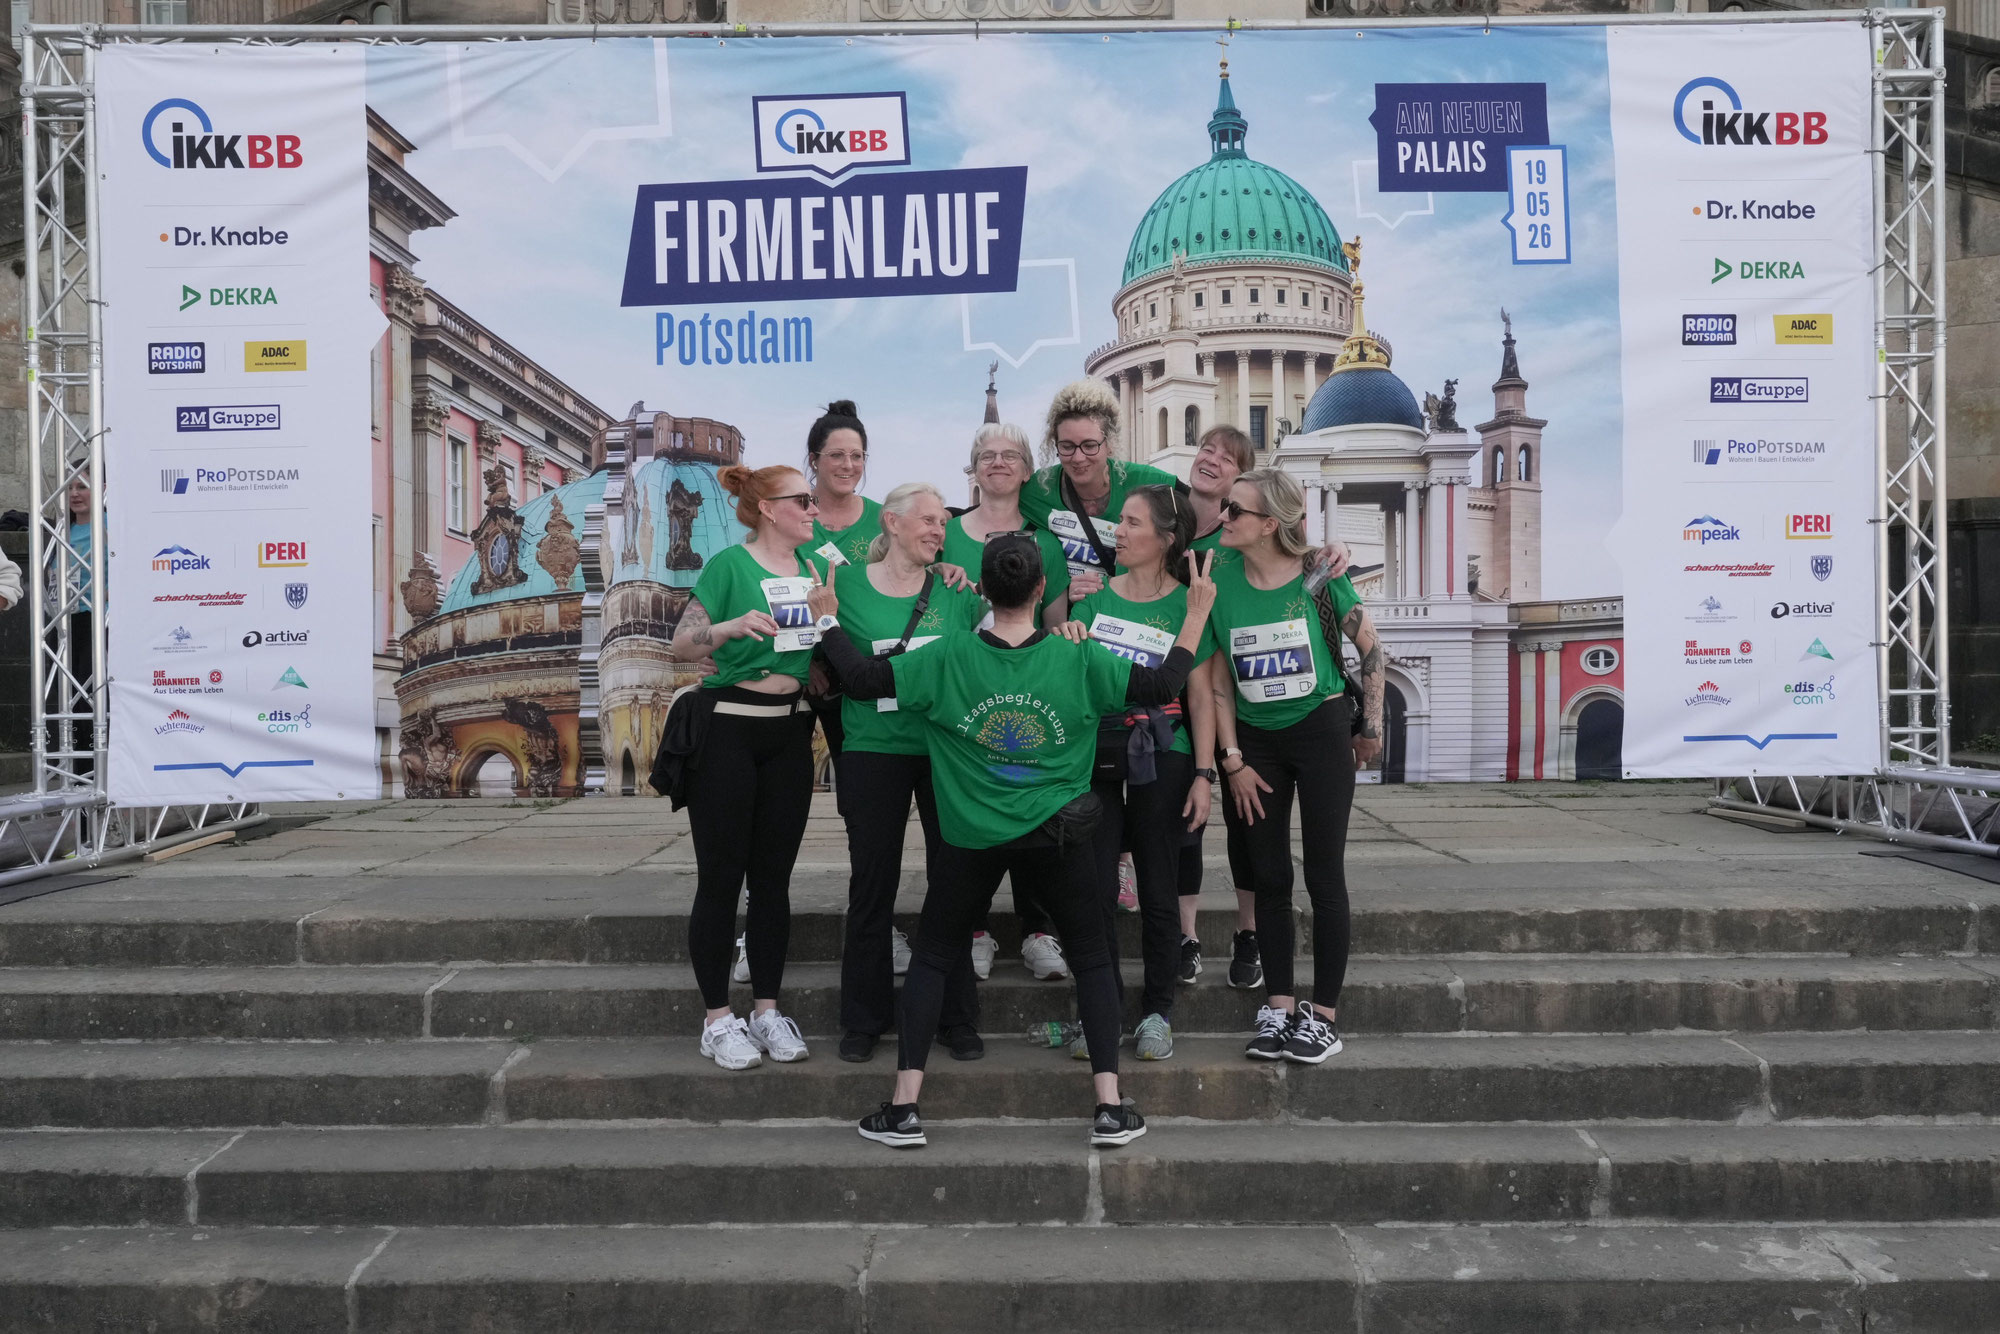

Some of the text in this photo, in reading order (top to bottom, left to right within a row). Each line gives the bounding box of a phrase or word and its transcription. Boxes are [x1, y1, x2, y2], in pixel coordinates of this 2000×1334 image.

[1396, 102, 1524, 134] AM NEUEN
[1398, 140, 1486, 173] PALAIS
[1525, 160, 1546, 184] 19
[1526, 192, 1550, 216] 05
[1707, 200, 1816, 220] Dr. Knabe
[174, 226, 289, 246] Dr. Knabe
[654, 191, 1000, 284] FIRMENLAUF
[1528, 224, 1552, 248] 26
[1740, 261, 1805, 280] DEKRA
[210, 287, 278, 306] DEKRA
[1685, 317, 1733, 332] RADIO
[1791, 320, 1817, 330] ADAC
[656, 310, 813, 366] Potsdam
[151, 346, 202, 360] RADIO
[262, 346, 290, 358] ADAC
[1714, 382, 1804, 399] 2M Gruppe
[180, 411, 276, 427] 2M Gruppe
[1793, 514, 1831, 533] PERI
[1683, 525, 1740, 545] impeak
[266, 542, 306, 560] PERI
[152, 554, 210, 575] impeak
[1684, 562, 1775, 572] schachtschneider
[153, 591, 247, 602] schachtschneider
[1146, 636, 1166, 648] DEKRA
[1281, 631, 1303, 640] DEKRA
[1684, 648, 1730, 656] JOHANNITER
[1243, 651, 1299, 678] 7714
[152, 678, 200, 686] JOHANNITER
[204, 686, 224, 694] Leben
[1784, 682, 1815, 693] e.dis
[1685, 692, 1732, 706] Lichtenauer
[1793, 695, 1823, 705] com
[258, 711, 292, 722] e.dis
[154, 722, 205, 736] Lichtenauer
[268, 723, 298, 733] com
